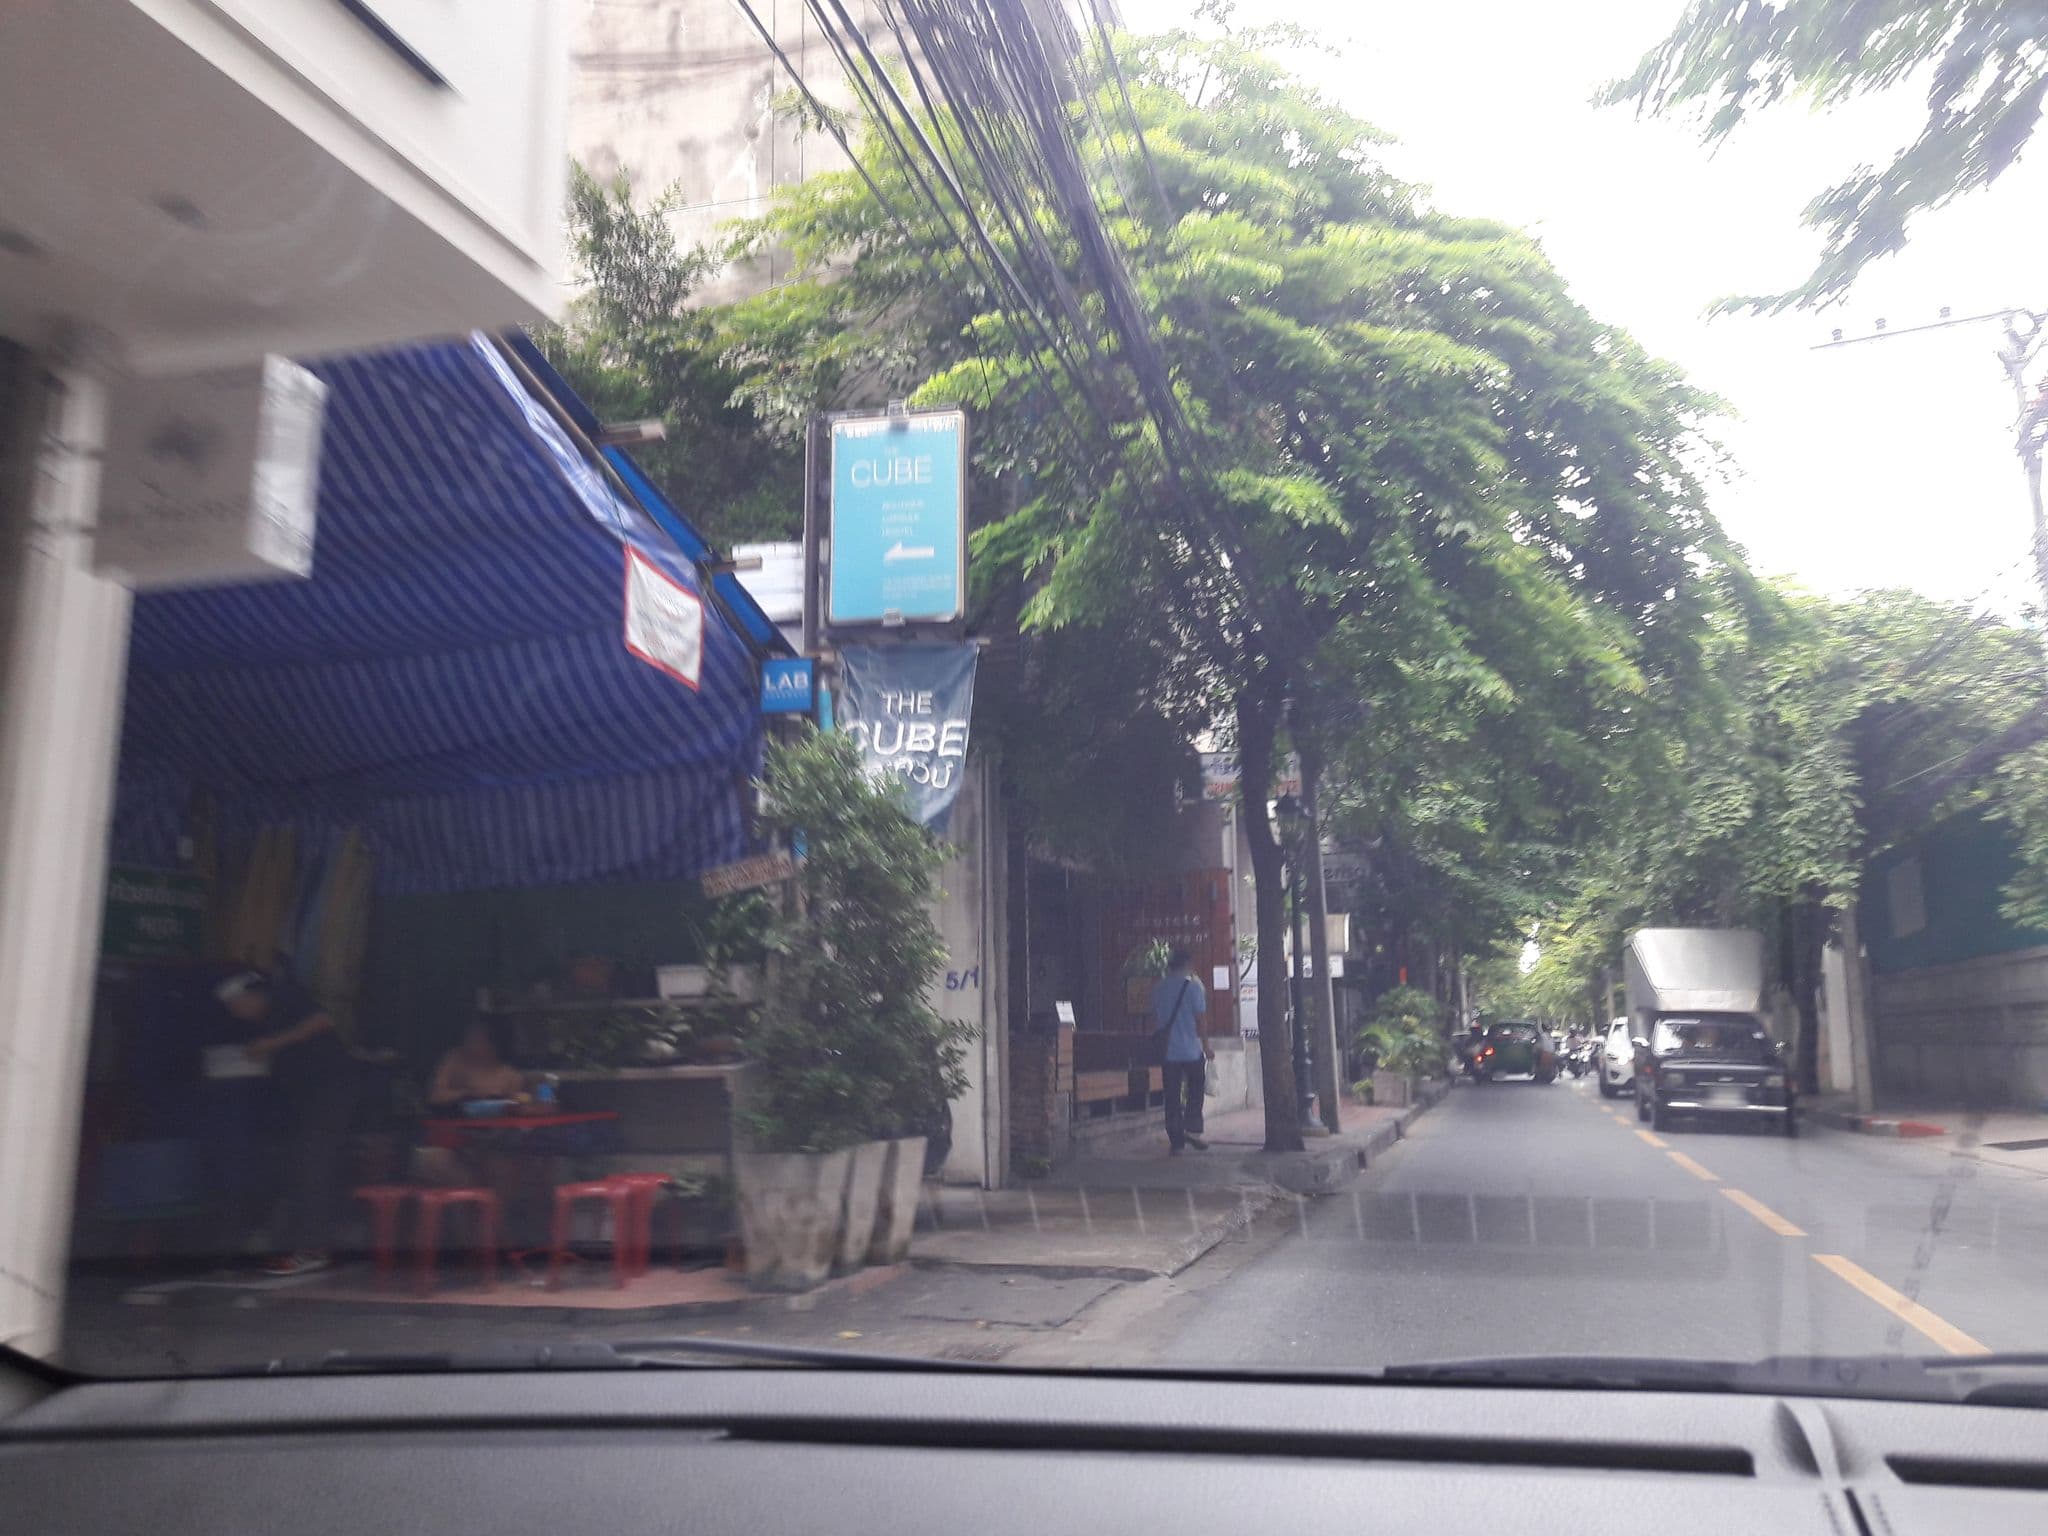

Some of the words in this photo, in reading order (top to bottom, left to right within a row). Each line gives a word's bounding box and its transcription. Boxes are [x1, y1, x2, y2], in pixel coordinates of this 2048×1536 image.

[851, 455, 932, 488] CUBE
[765, 671, 808, 690] LAB
[881, 689, 933, 715] THE
[945, 967, 979, 991] 5/1
